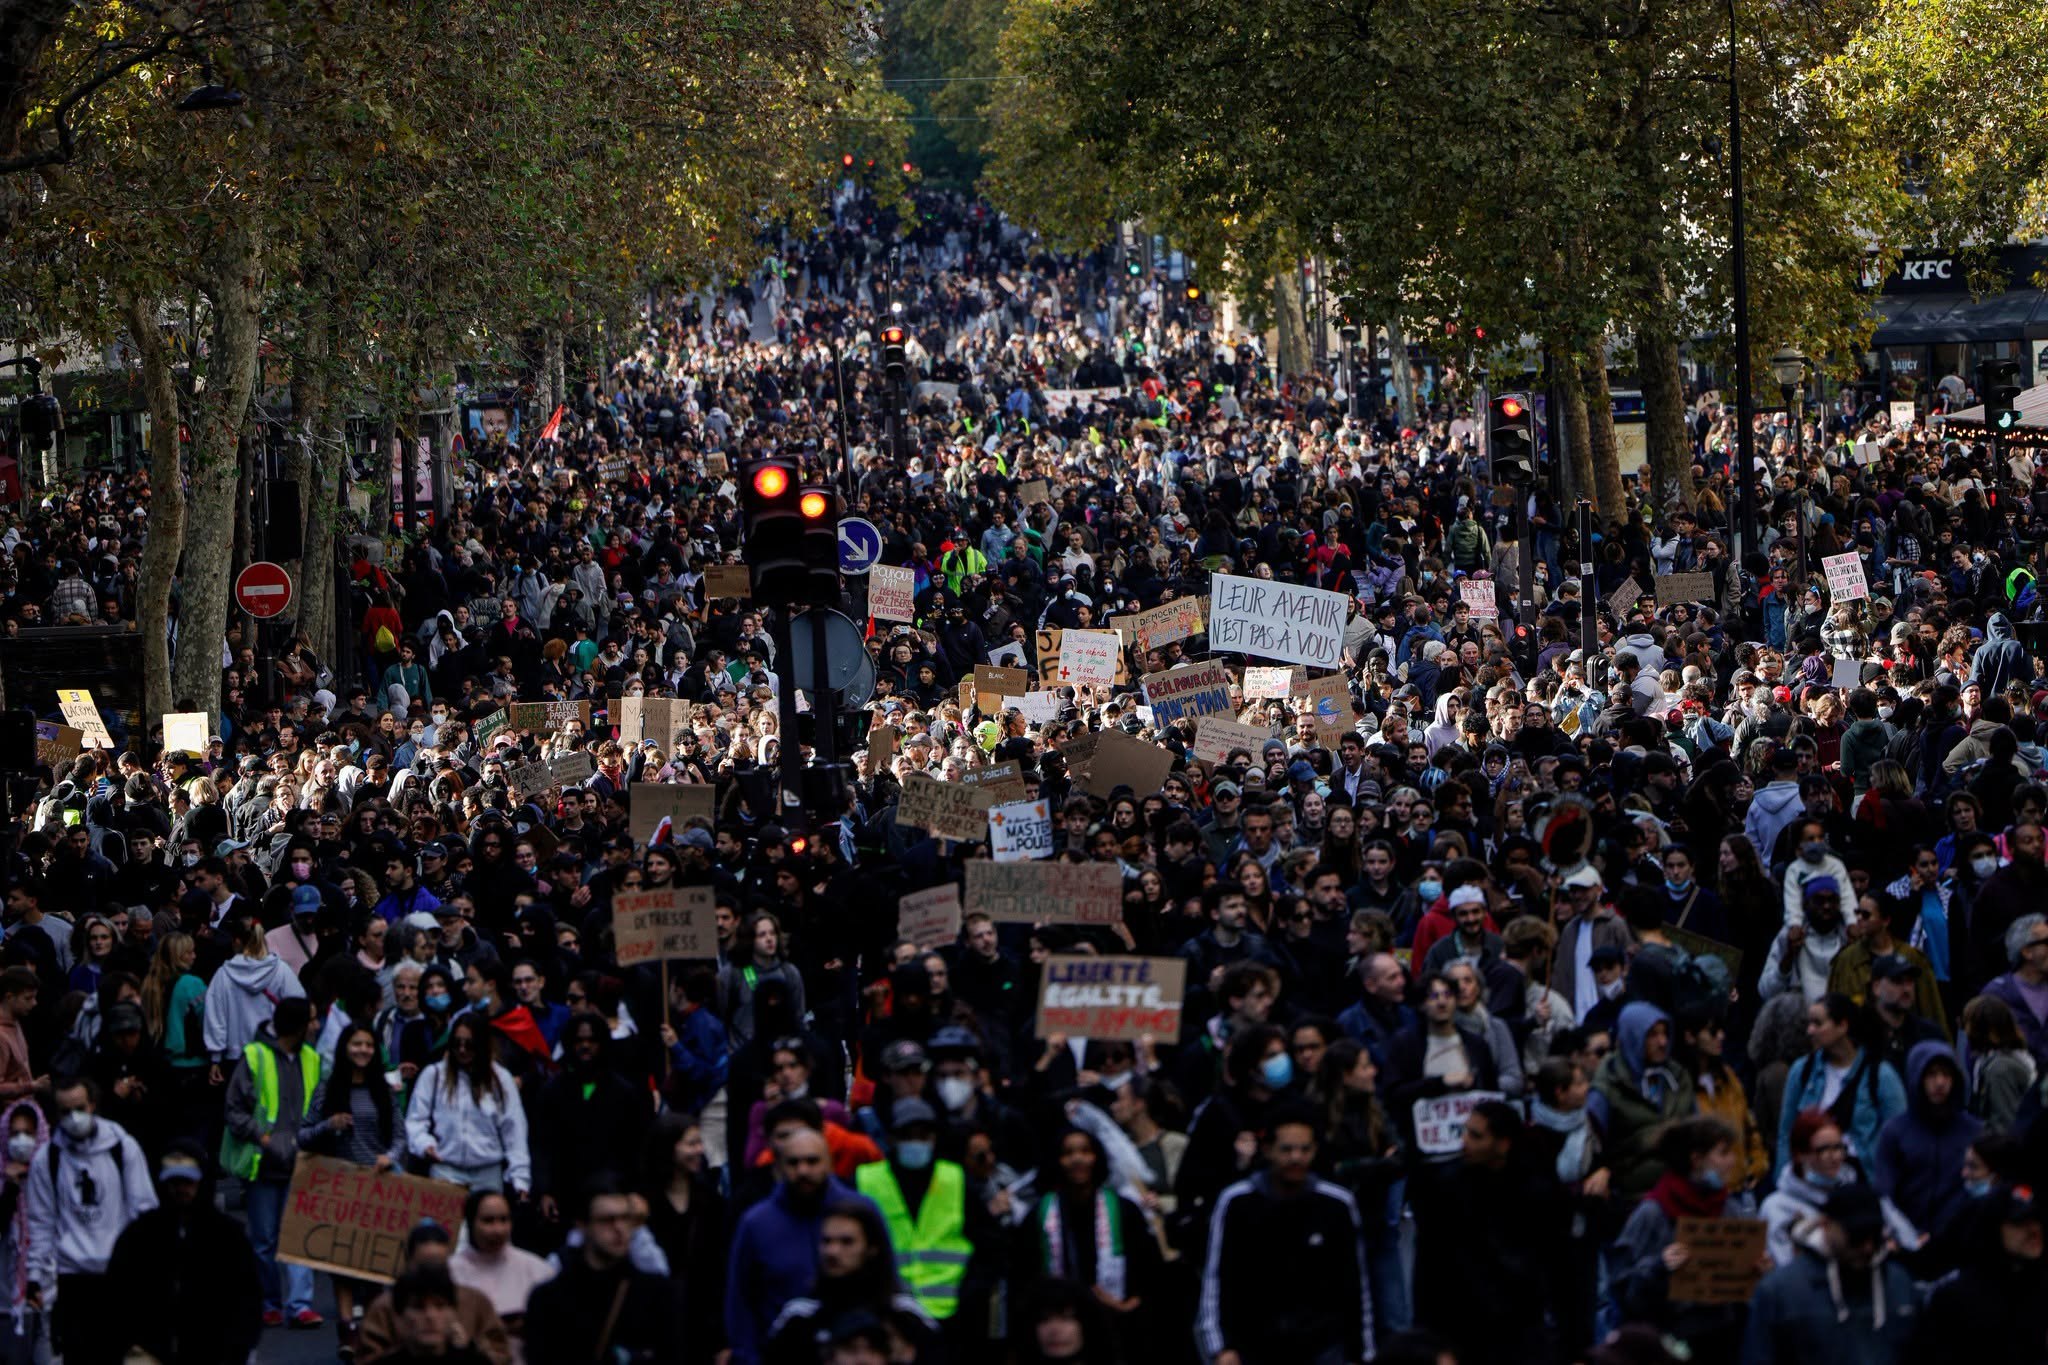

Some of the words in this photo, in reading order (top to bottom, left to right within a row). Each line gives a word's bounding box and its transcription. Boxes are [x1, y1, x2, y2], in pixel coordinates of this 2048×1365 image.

[1902, 259, 1952, 281] KFC
[1891, 360, 1919, 370] SAUCY
[1140, 601, 1193, 627] DEMOCRATIE
[1218, 581, 1267, 617] LEUR
[1272, 590, 1342, 635] AVENIR
[1212, 617, 1249, 645] N'EST
[1249, 623, 1276, 650] PAS
[1277, 621, 1292, 653] À
[1297, 630, 1337, 664] VOUS
[1175, 674, 1200, 694] POUR
[63, 705, 97, 718] LACRYMO
[549, 711, 579, 720] PARENTS
[562, 702, 579, 711] NOS
[73, 721, 104, 734] CRATIE
[963, 774, 978, 783] ON
[634, 910, 694, 930] DETRESSE
[1049, 959, 1153, 983] LIBERTÉ
